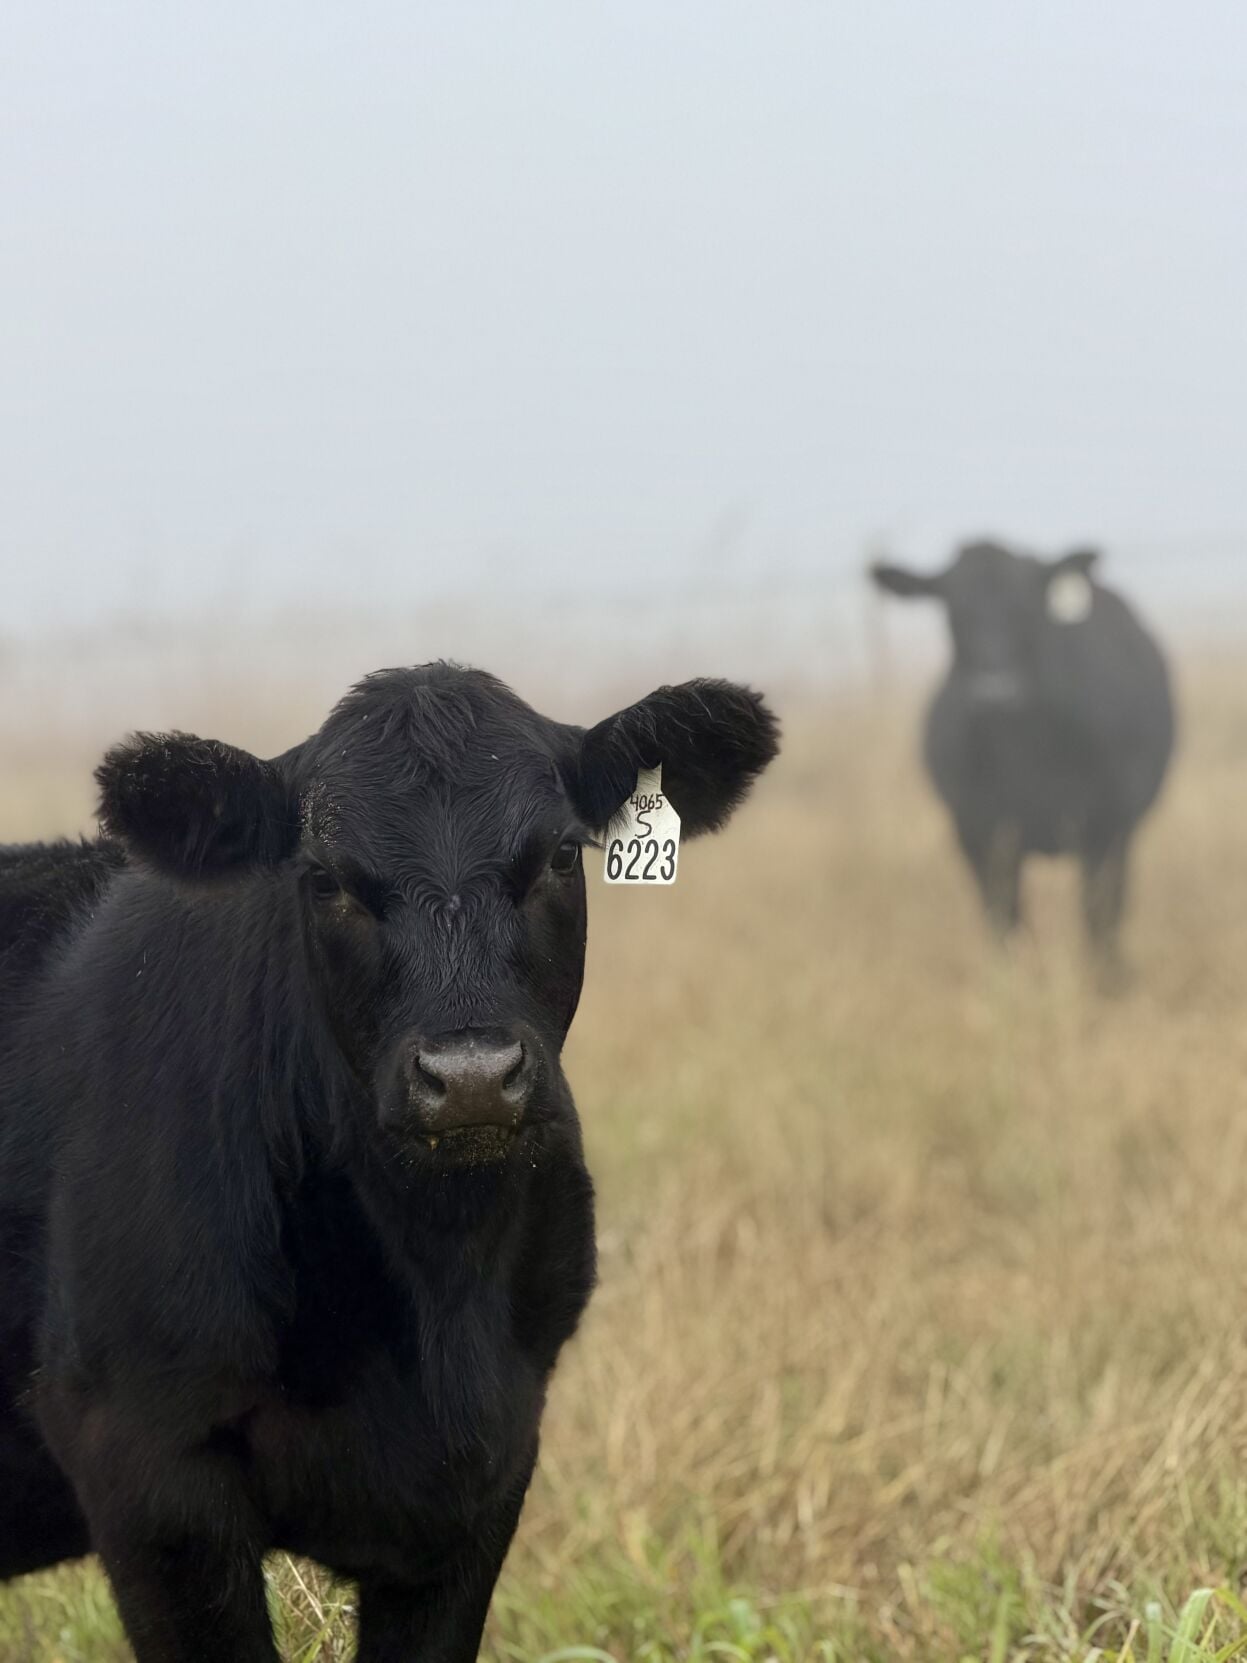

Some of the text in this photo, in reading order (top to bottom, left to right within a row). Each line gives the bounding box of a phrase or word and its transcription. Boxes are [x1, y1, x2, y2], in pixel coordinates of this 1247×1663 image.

[630, 794, 664, 811] 4065
[635, 810, 652, 839] S
[607, 839, 676, 880] 6223
